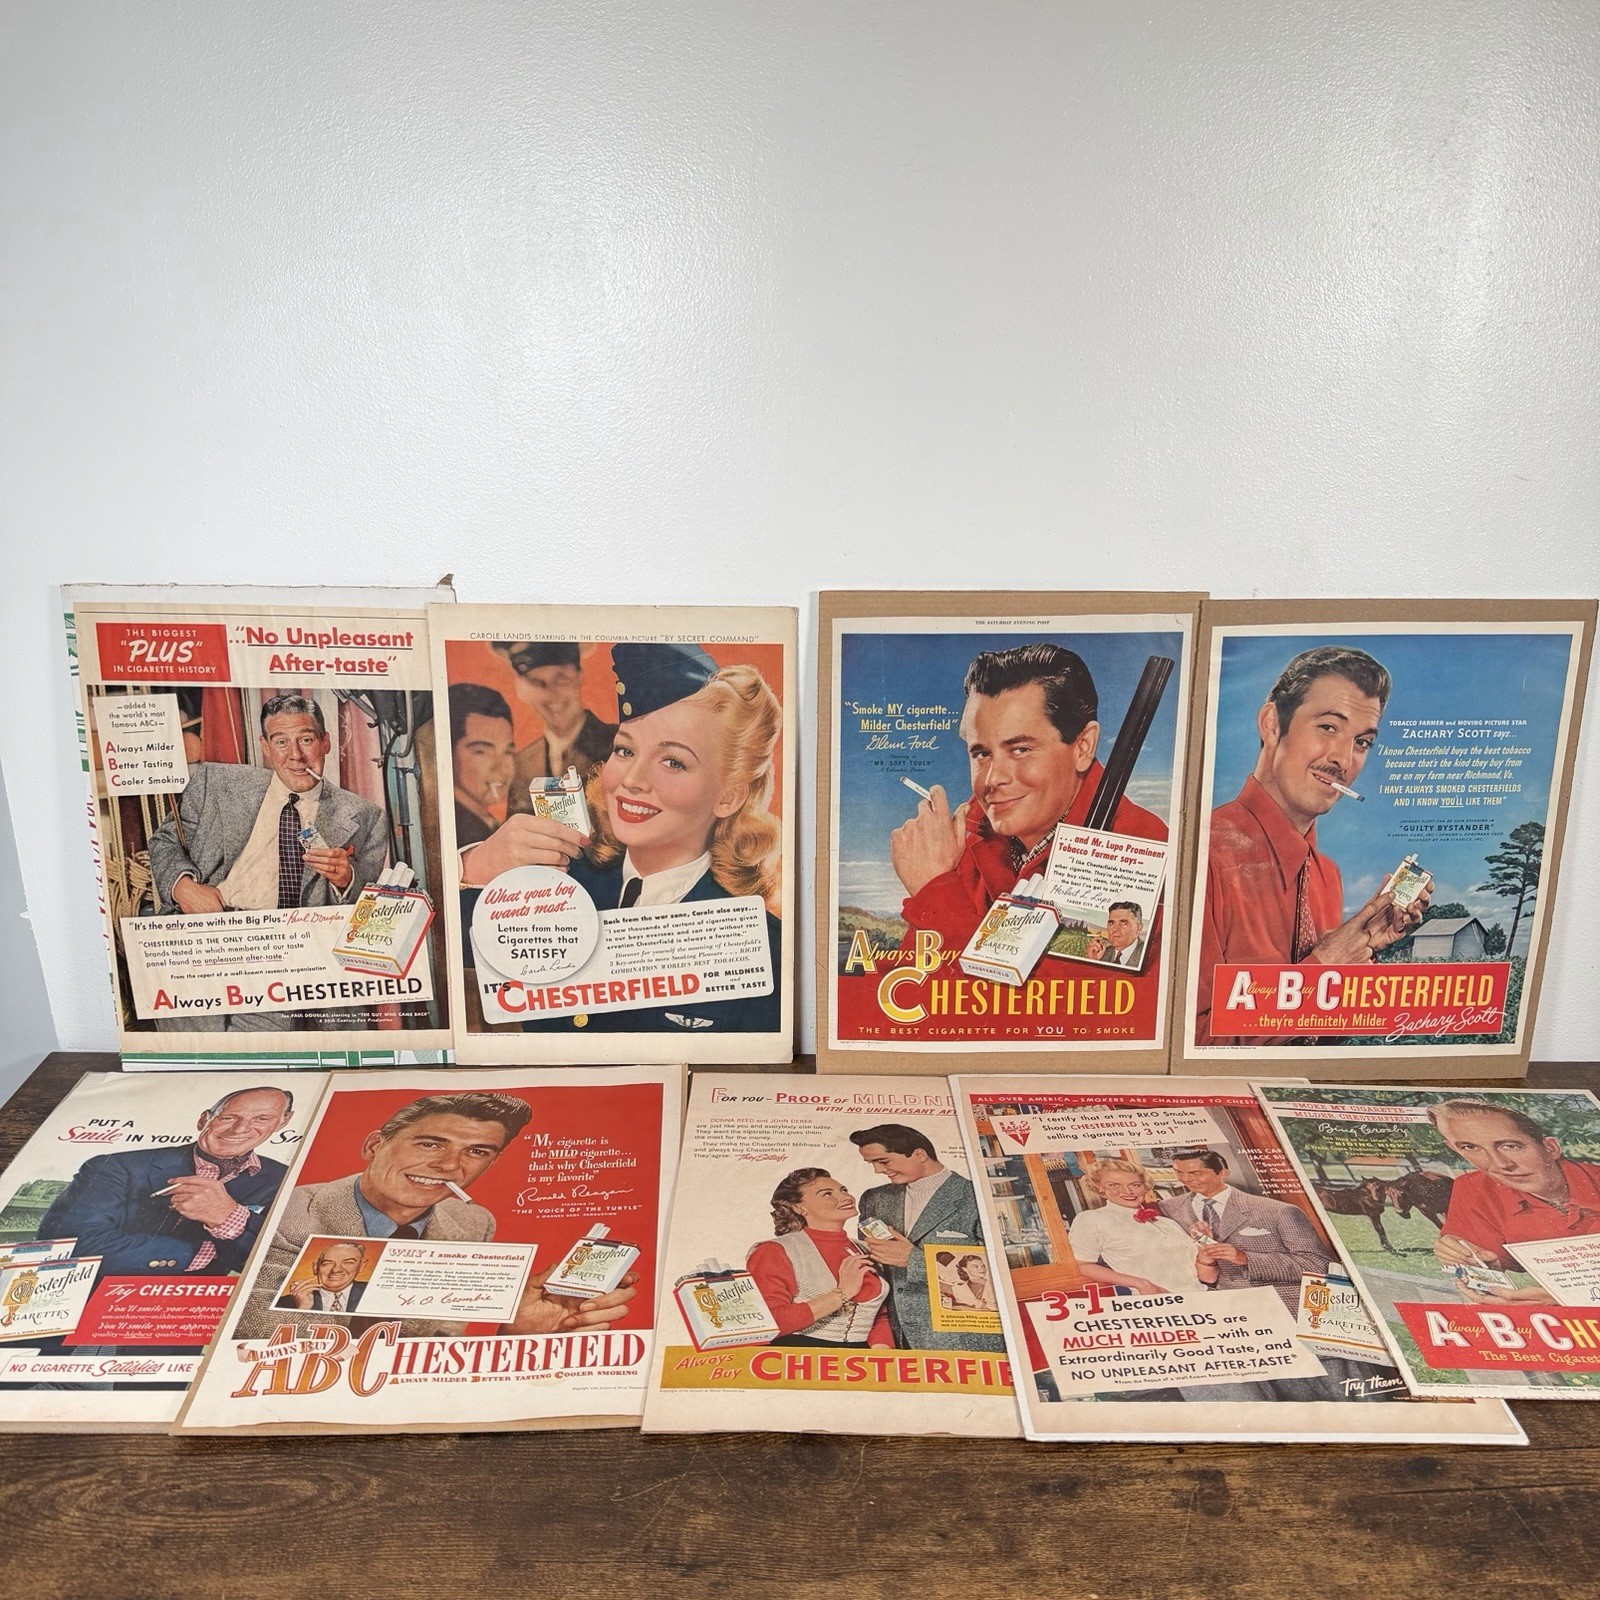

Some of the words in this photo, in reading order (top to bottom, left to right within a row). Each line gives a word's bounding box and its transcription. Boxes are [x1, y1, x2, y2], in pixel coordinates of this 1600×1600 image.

[126, 629, 148, 637] THE
[152, 629, 197, 638] BIGGEST
[288, 627, 413, 649] Unpleasant
[127, 665, 174, 674] CIGARETTE
[178, 666, 216, 674] HISTORY
[888, 704, 904, 714] MY
[861, 719, 891, 730] Milder
[1403, 729, 1453, 739] ZACHARY
[1458, 728, 1492, 738] SCOTT
[106, 741, 143, 753] Always
[146, 742, 174, 751] Milder
[865, 735, 906, 751] Glenn
[908, 736, 939, 749] Ford
[108, 758, 140, 770] Better
[143, 760, 173, 770] Tasting
[111, 775, 144, 787] Cooler
[148, 775, 185, 786] Smoking
[1385, 785, 1402, 793] HAVE
[1405, 785, 1433, 793] ALWAYS
[1468, 784, 1521, 792] CHESTERFIELDS
[1394, 798, 1409, 806] AND
[1417, 797, 1438, 806] KNOW
[1441, 795, 1463, 805] YOU'LL
[1466, 797, 1480, 805] LIKE
[1059, 843, 1088, 856] Tobacco
[1092, 850, 1118, 861] Farmer
[1092, 837, 1103, 847] Mr.
[1106, 841, 1123, 853] Lupo
[1126, 844, 1165, 858] Prominent
[484, 888, 520, 905] What
[524, 888, 551, 904] your
[555, 882, 577, 899] boy
[490, 906, 530, 920] wants
[149, 921, 162, 929] the
[166, 920, 186, 930] only
[229, 916, 242, 925] the
[246, 915, 260, 925] Big
[498, 924, 528, 932] Letters
[498, 935, 552, 946] Cigarettes
[558, 936, 578, 944] that
[511, 949, 567, 959] SATISFY
[845, 930, 914, 973] Always
[916, 930, 961, 974] Buy
[724, 967, 765, 976] MILDNESS
[154, 988, 221, 1010] Always
[226, 985, 263, 1006] Buy
[267, 978, 422, 1003] CHESTERFIELD
[484, 982, 511, 993] IT'S
[497, 974, 700, 1013] CHESTERFIELD
[705, 984, 736, 993] BETTER
[741, 981, 767, 989] TASTE
[1317, 970, 1494, 1010] CHESTERFIELD
[877, 967, 1135, 1025] CHESTERFIELD
[1037, 1026, 1064, 1034] YOU
[1296, 1015, 1347, 1029] definitely
[1353, 1016, 1387, 1027] Milder
[1386, 1012, 1455, 1042] Zachary
[1454, 1007, 1507, 1032] Scott
[712, 1088, 737, 1103] FOR
[777, 1092, 830, 1103] PROOF
[89, 1118, 121, 1128] PUT
[125, 1120, 134, 1128] A
[1071, 1121, 1136, 1130] CHESTERFIELD
[58, 1126, 122, 1144] Smile
[126, 1134, 141, 1143] IN
[151, 1134, 192, 1144] YOUR
[557, 1137, 596, 1149] cigarette
[601, 1136, 609, 1145] is
[531, 1150, 546, 1158] the
[549, 1149, 578, 1158] MILD
[529, 1161, 554, 1171] that's
[557, 1161, 576, 1172] why
[579, 1158, 637, 1169] Chesterfield
[527, 1174, 536, 1182] is
[539, 1174, 555, 1185] my
[516, 1187, 566, 1206] Ronald
[572, 1184, 633, 1200] Reagan
[104, 1284, 137, 1303] Try
[1042, 1291, 1069, 1321] 3
[1087, 1284, 1104, 1315] 1
[1112, 1294, 1183, 1312] because
[1074, 1314, 1216, 1334] CHESTERFIELDS
[1223, 1315, 1247, 1324] are
[1063, 1333, 1123, 1349] MUCH
[1130, 1329, 1198, 1345] MILDER
[1255, 1326, 1272, 1336] an
[1060, 1350, 1168, 1366] Extraordinarily
[1173, 1345, 1214, 1358] Good
[1219, 1343, 1259, 1356] Taste,
[1265, 1338, 1292, 1350] and
[1479, 1351, 1507, 1361] The
[1511, 1352, 1544, 1362] Best
[9, 1364, 26, 1372] NO
[31, 1364, 95, 1373] CIGARETTE
[92, 1359, 165, 1376] Satisfies
[167, 1363, 193, 1372] LIKE
[674, 1352, 734, 1371] Always
[389, 1376, 429, 1385] ALWAYS
[471, 1374, 512, 1383] BETTER
[515, 1372, 552, 1381] TASTING
[555, 1371, 594, 1380] COOLER
[598, 1369, 638, 1377] SMOKING
[710, 1366, 741, 1381] Buy
[1072, 1369, 1095, 1381] NO
[1101, 1362, 1197, 1378] UNPLEASANT
[1340, 1378, 1368, 1398] Try
[1370, 1376, 1404, 1389] them
